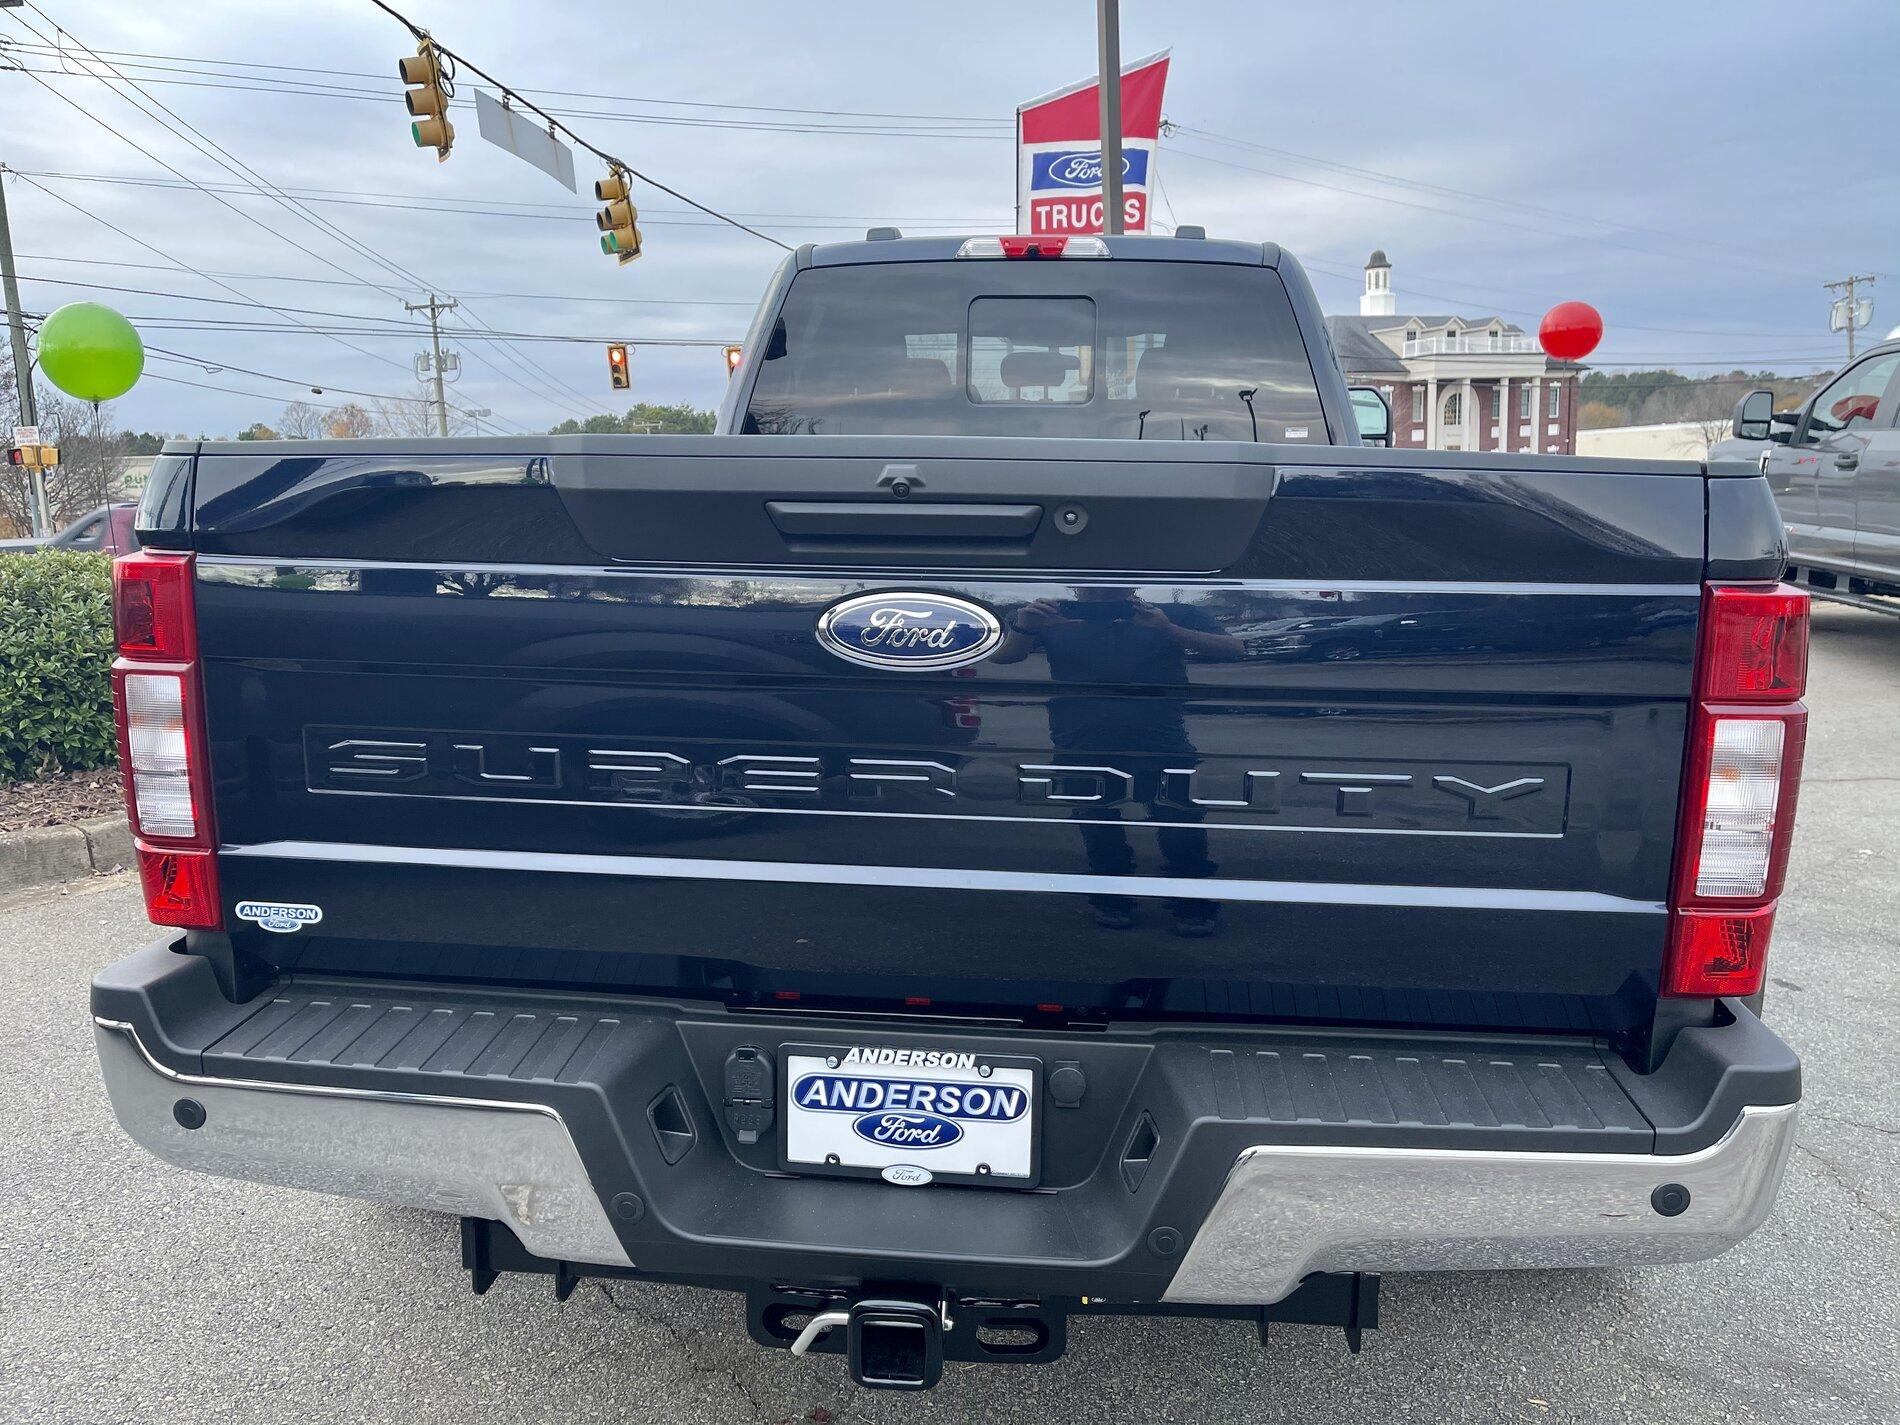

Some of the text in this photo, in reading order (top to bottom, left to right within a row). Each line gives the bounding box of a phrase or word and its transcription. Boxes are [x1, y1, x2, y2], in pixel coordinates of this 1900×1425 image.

[1036, 198, 1140, 230] TRUCS
[860, 607, 957, 649] Ford
[323, 739, 1546, 820] SUPER DUTY
[242, 905, 316, 920] ANDERSON
[268, 918, 292, 929] Ford
[843, 1047, 976, 1069] ANDERSON
[800, 1078, 1021, 1118] ANDERSON
[873, 1113, 943, 1144] Ford
[892, 1169, 922, 1182] Ford
